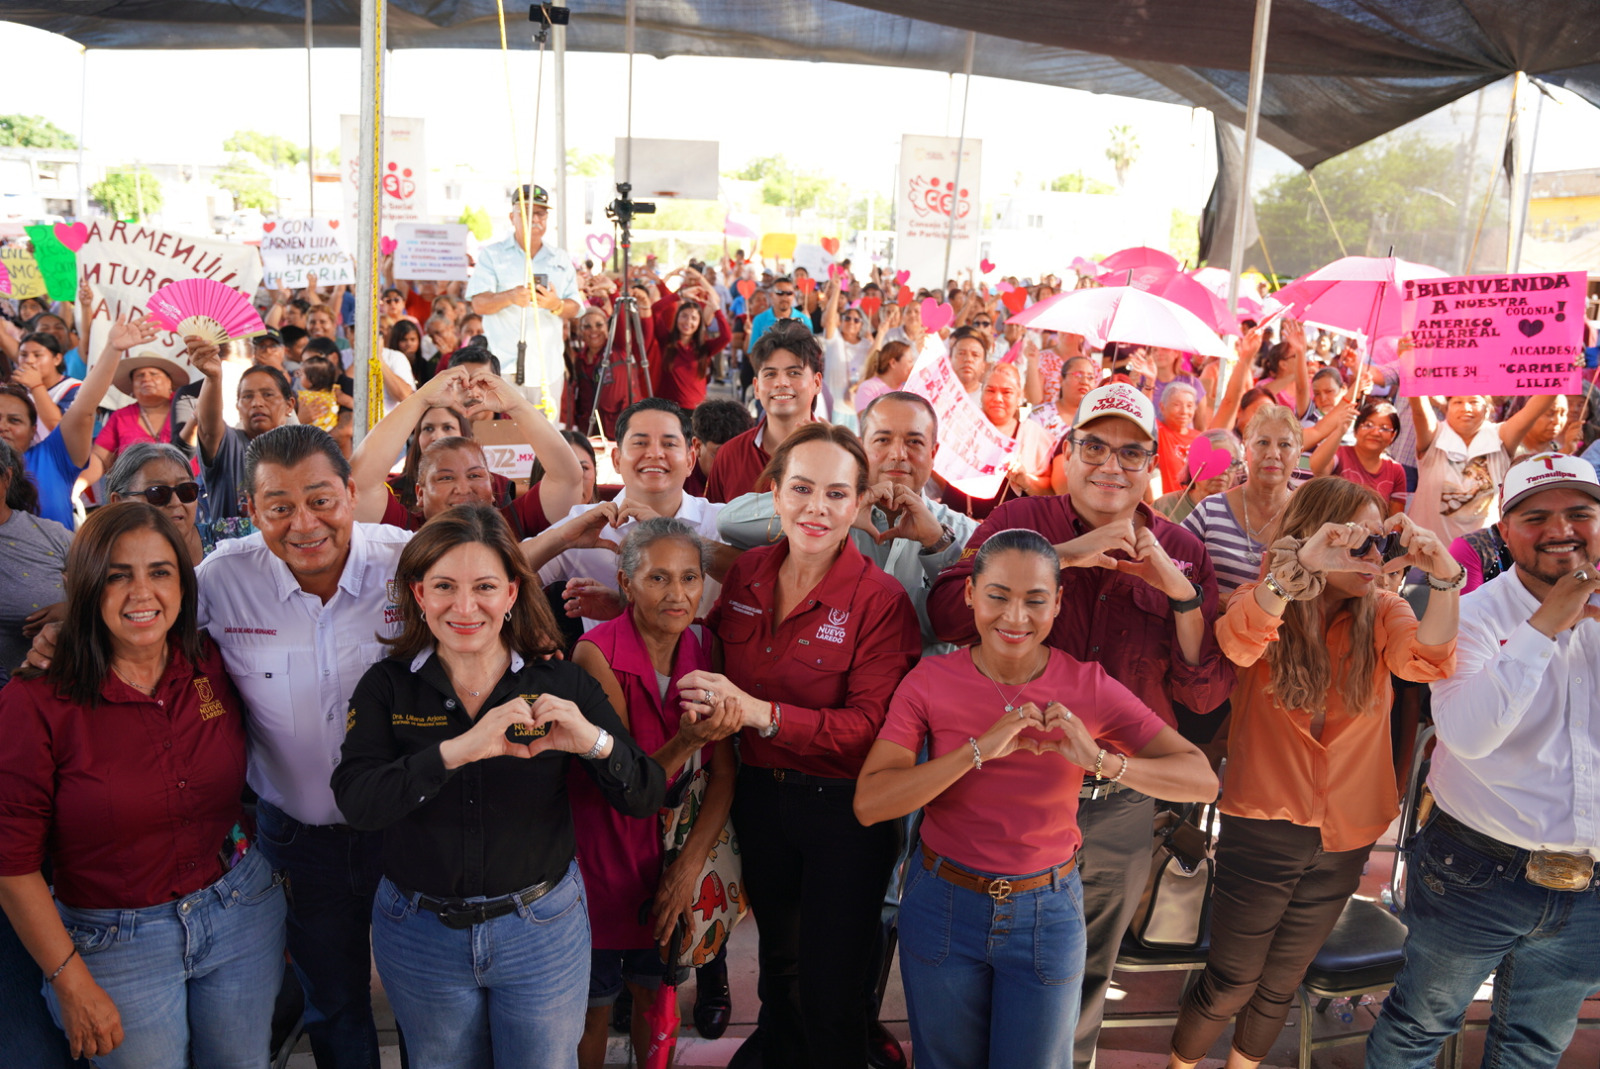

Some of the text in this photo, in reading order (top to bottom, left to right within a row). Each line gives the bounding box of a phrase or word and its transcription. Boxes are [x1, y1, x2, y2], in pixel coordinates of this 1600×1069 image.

[282, 220, 312, 234] CON
[944, 222, 966, 230] Sial
[919, 231, 969, 239] Participción
[286, 251, 349, 267] HACEMOS
[1404, 275, 1571, 301] ¡BIENVENIDA
[1431, 297, 1529, 315] A NUESTRA
[1418, 318, 1493, 329] AMERICO
[1411, 328, 1501, 340] VILLAREAL
[1414, 339, 1478, 349] GUERRA
[1463, 366, 1477, 377] 34
[1525, 470, 1577, 484] Tamaulipas
[816, 632, 844, 644] LAREDO
[819, 626, 846, 638] NUEVO
